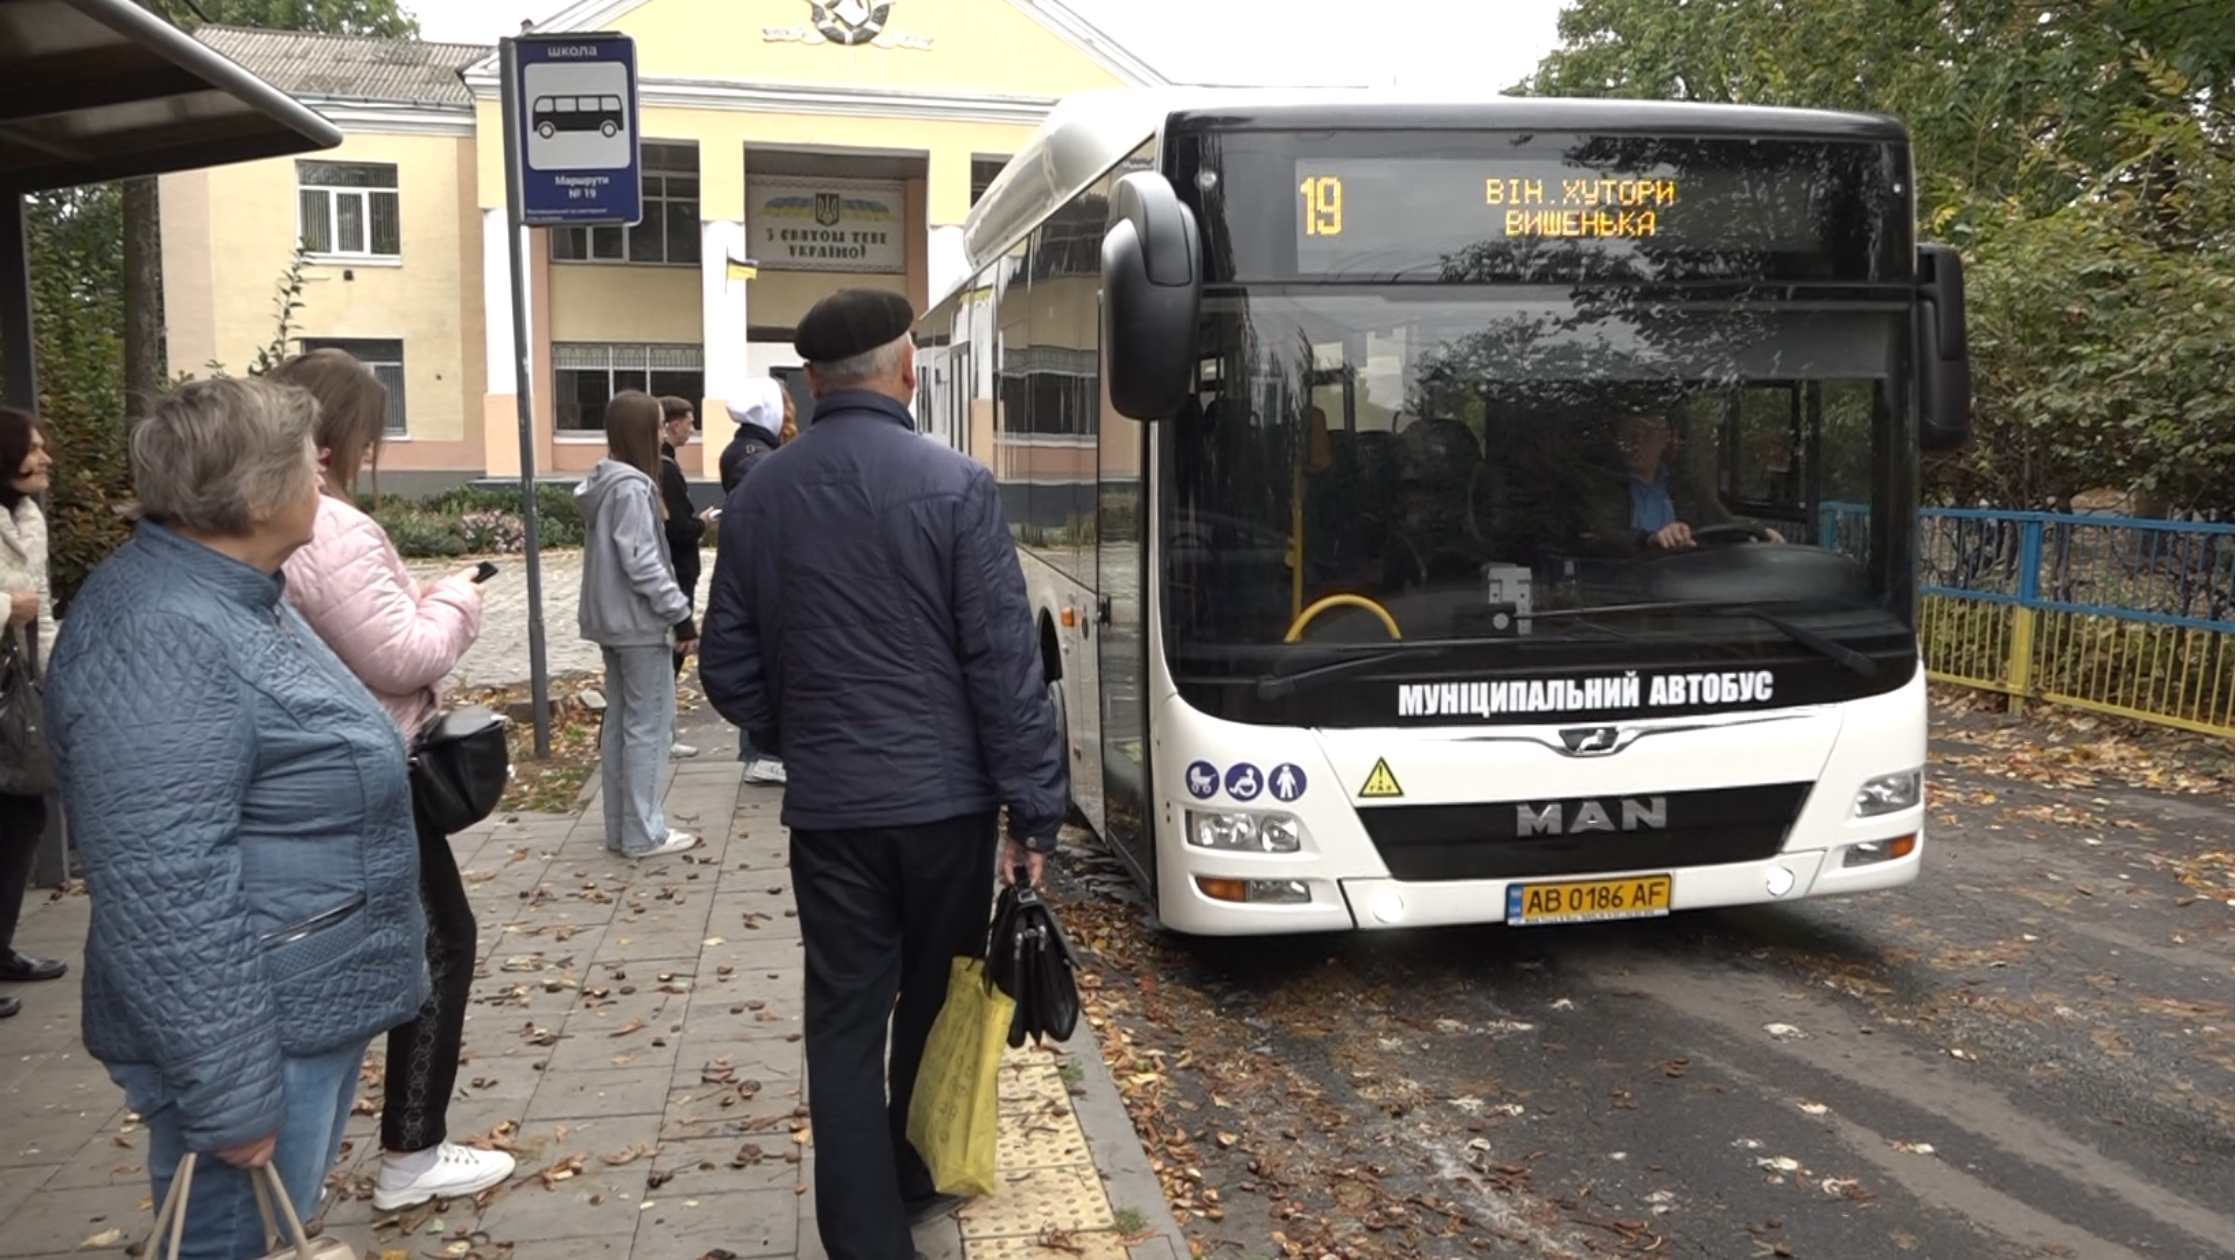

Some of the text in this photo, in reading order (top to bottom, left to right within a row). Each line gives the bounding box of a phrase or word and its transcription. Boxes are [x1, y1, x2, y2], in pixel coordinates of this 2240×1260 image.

[547, 45, 599, 57] школа
[584, 188, 597, 199] 19
[1299, 176, 1343, 237] 19
[1504, 210, 1656, 238] ВИШЕНЬКА
[1398, 670, 1774, 718] МУНІЦИПАЛЬНИЙ АВТОБУС
[1515, 797, 1668, 838] MAN
[1526, 882, 1666, 914] AB 0186 AF
